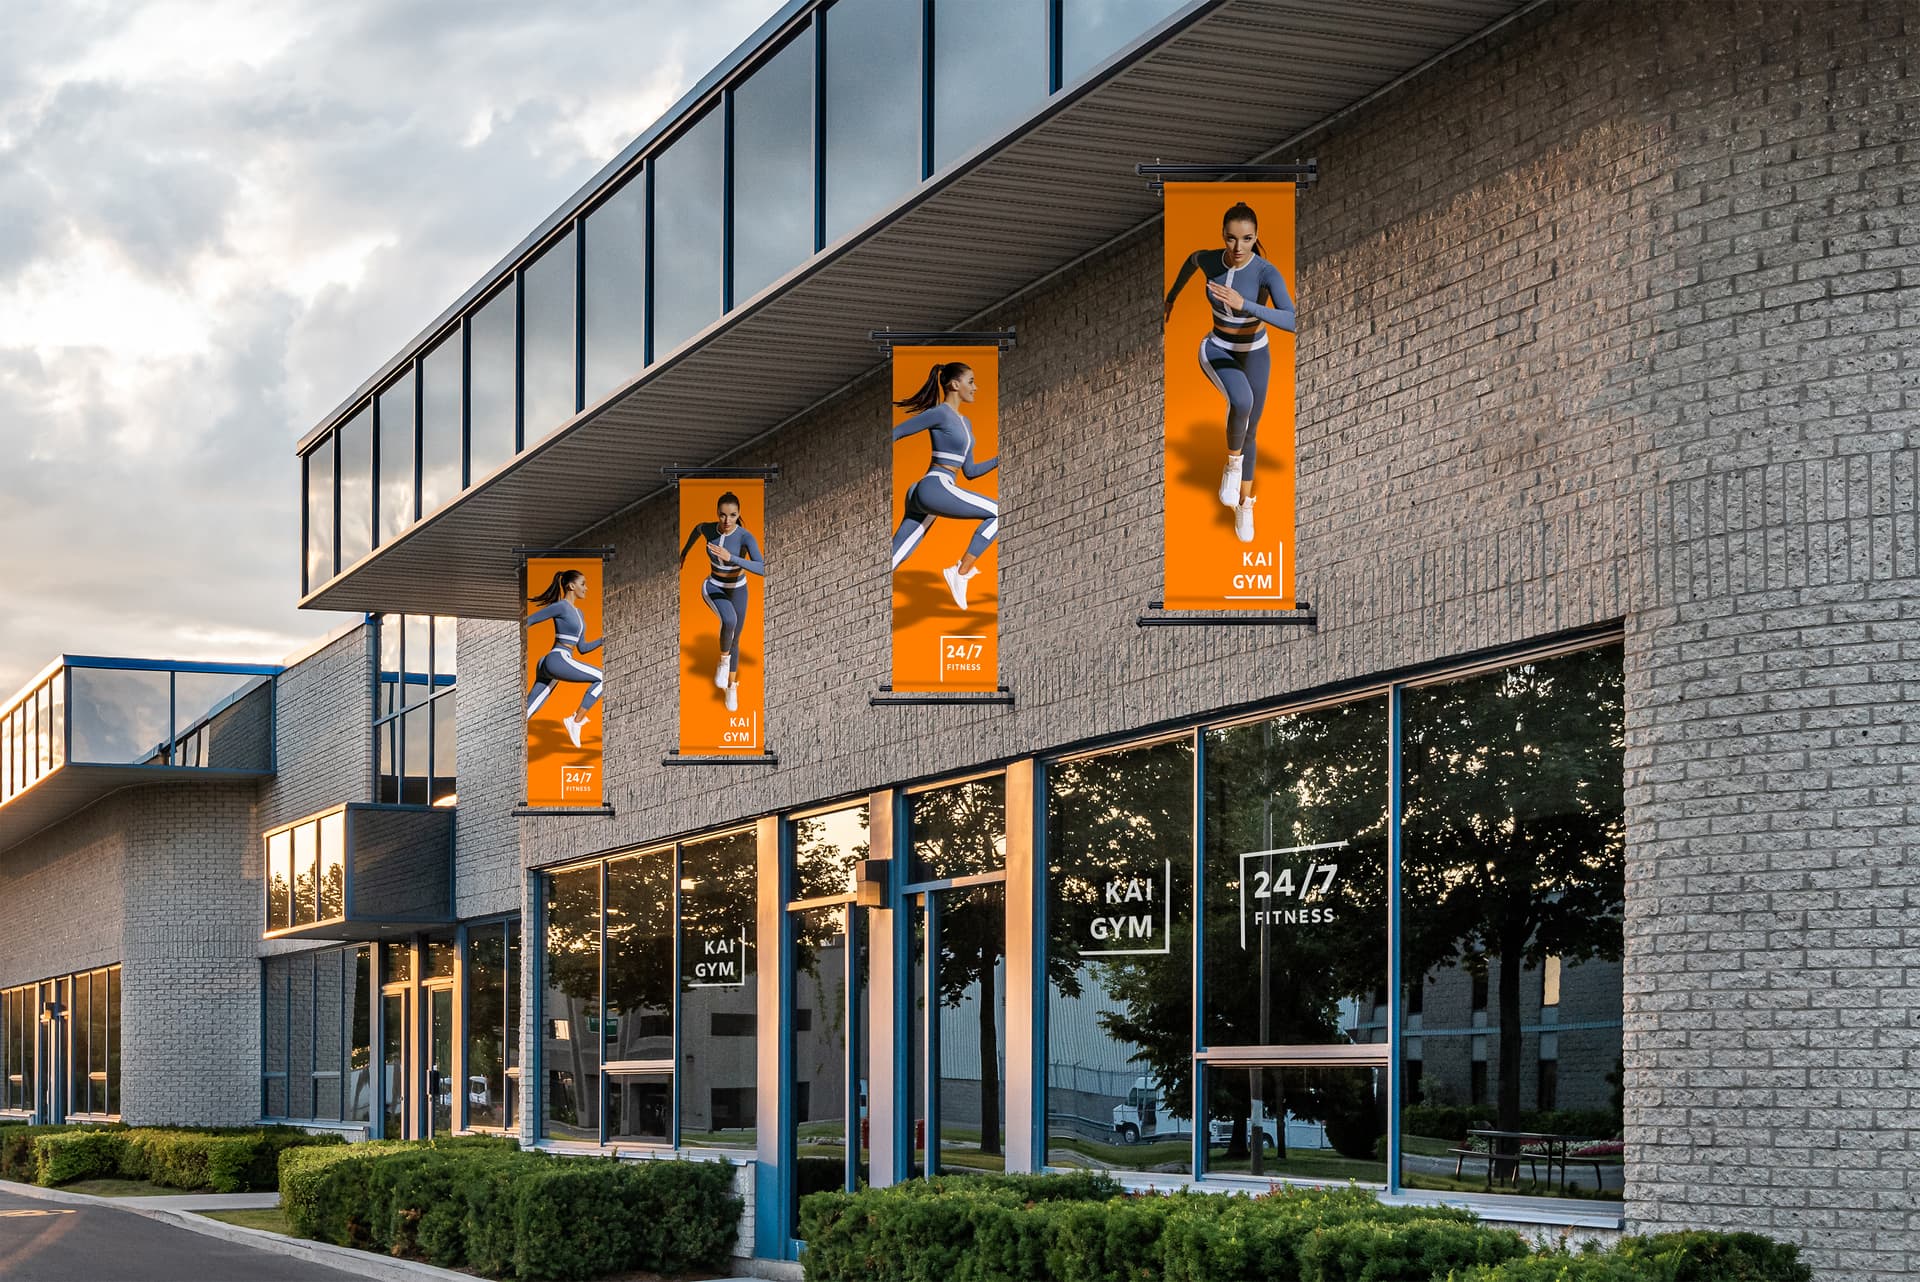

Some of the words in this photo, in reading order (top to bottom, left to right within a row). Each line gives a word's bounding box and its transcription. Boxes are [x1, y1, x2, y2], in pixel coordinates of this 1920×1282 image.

[1243, 551, 1273, 567] KAI
[1232, 574, 1273, 590] GYM
[946, 643, 983, 661] 24/7
[946, 663, 981, 671] FITNESS
[730, 717, 750, 728] KAI
[723, 731, 750, 742] GYM
[566, 771, 592, 784] 24/7
[1254, 863, 1338, 899] 24/7
[1105, 878, 1152, 904] KAI
[1254, 907, 1335, 925] FITNESS
[1090, 915, 1152, 940] GYM
[704, 938, 735, 955] KAI
[695, 961, 735, 978] GYM
